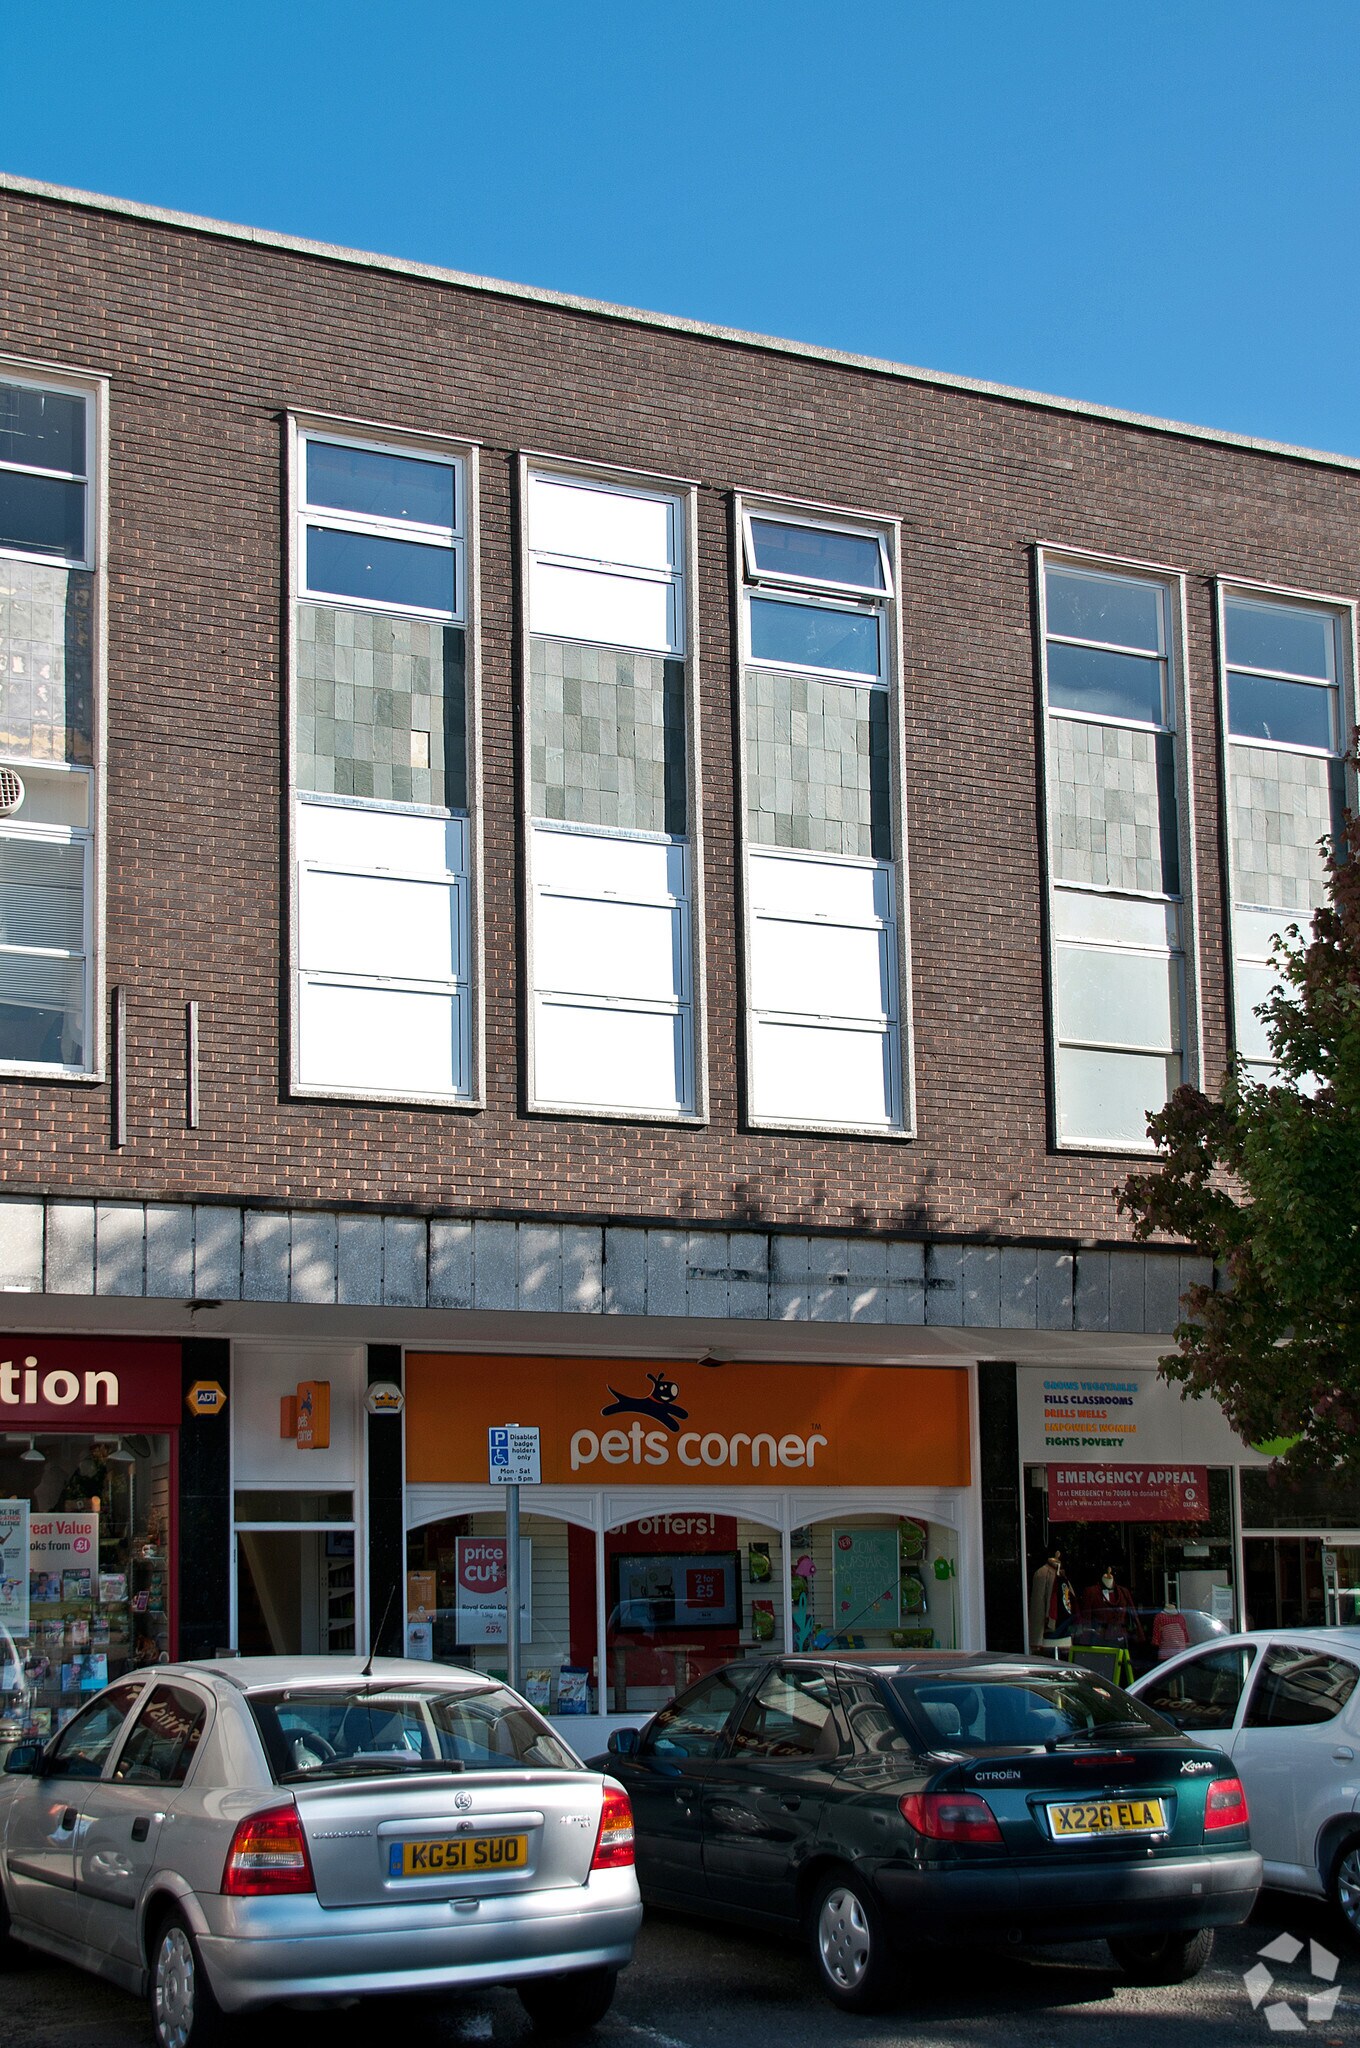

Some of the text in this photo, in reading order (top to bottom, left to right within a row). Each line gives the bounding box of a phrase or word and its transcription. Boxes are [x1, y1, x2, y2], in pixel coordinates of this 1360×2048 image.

[0, 1355, 119, 1406] tion
[1043, 1381, 1138, 1393] GROWS VEGETABLES
[198, 1391, 217, 1402] ADT
[1044, 1395, 1134, 1405] FILLS CLASSROOMS
[1044, 1409, 1107, 1419] DRILLS WELLS
[1045, 1423, 1137, 1433] EMPOWERS WOMEN
[570, 1421, 828, 1471] pets corner
[1045, 1437, 1124, 1446] FIGHTS POVERTY
[1056, 1471, 1198, 1484] EMERGENCY APPEAL
[1056, 1489, 1070, 1497] Text
[1070, 1489, 1104, 1497] EMERGENCY
[1105, 1489, 1112, 1497] to
[1131, 1489, 1139, 1497] to
[1139, 1489, 1160, 1497] donate
[1079, 1499, 1131, 1508] www.oxfam.org.uk
[56, 1521, 92, 1535] Value
[49, 1540, 71, 1551] from
[74, 1539, 89, 1551] £1
[464, 1544, 504, 1563] price
[464, 1561, 500, 1582] cut
[695, 1573, 715, 1582] 2 for
[696, 1585, 714, 1598] £5
[462, 1603, 479, 1611] Royal
[486, 1625, 502, 1634] 25%
[1180, 1759, 1213, 1773] Xsara
[974, 1769, 1021, 1781] CITROËN
[1059, 1801, 1155, 1830] X226 ELA
[412, 1838, 519, 1869] KG51 SUO
